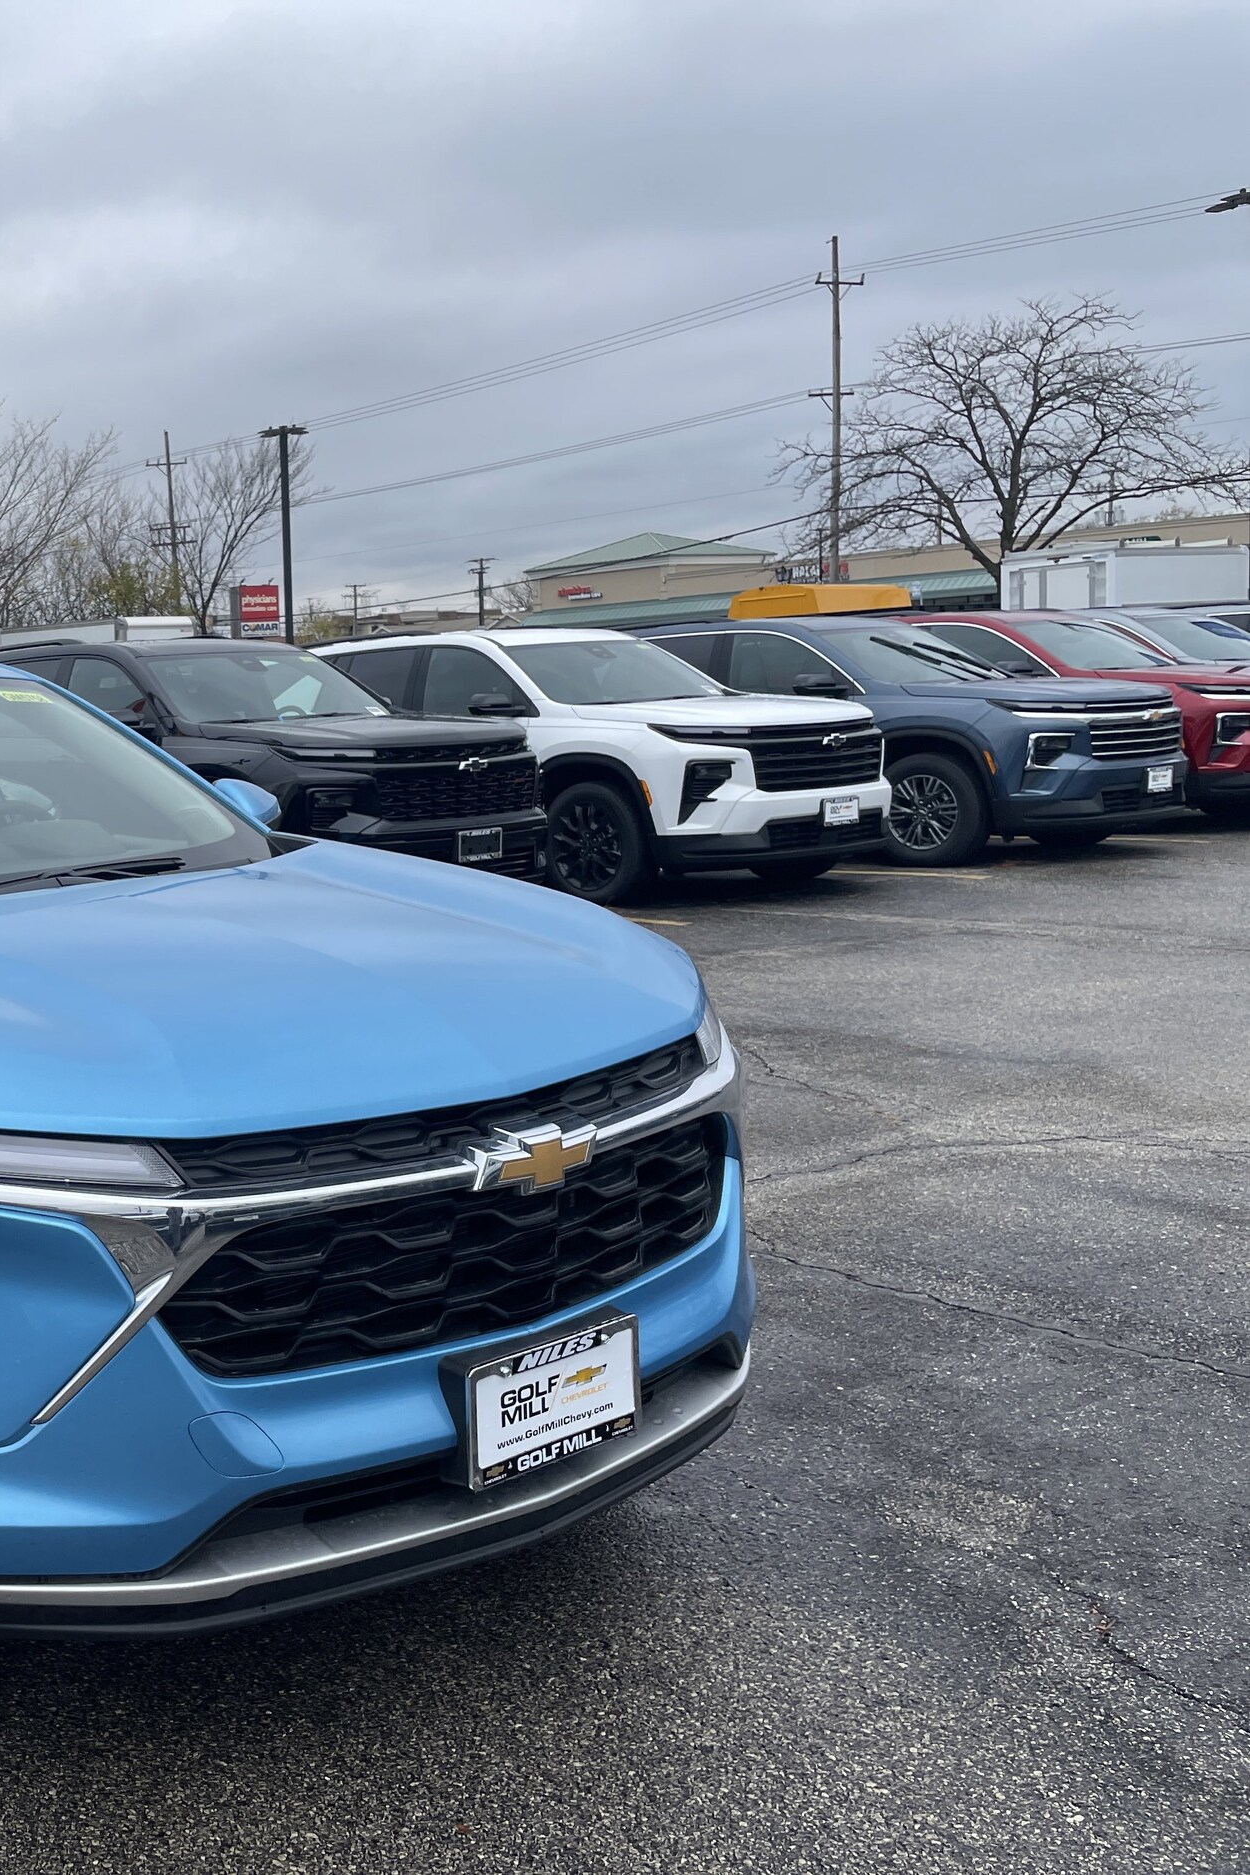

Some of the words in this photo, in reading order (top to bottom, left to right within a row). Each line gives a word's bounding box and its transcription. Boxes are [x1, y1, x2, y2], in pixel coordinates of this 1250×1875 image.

[241, 594, 277, 606] physicians
[517, 1332, 597, 1373] NILES
[500, 1373, 561, 1409] GOLF
[561, 1382, 608, 1405] CHEVROLET
[497, 1402, 614, 1450] www.GolfMillChevy.com
[501, 1397, 550, 1428] MILL
[517, 1441, 562, 1472] GOLF
[562, 1429, 603, 1455] MILL
